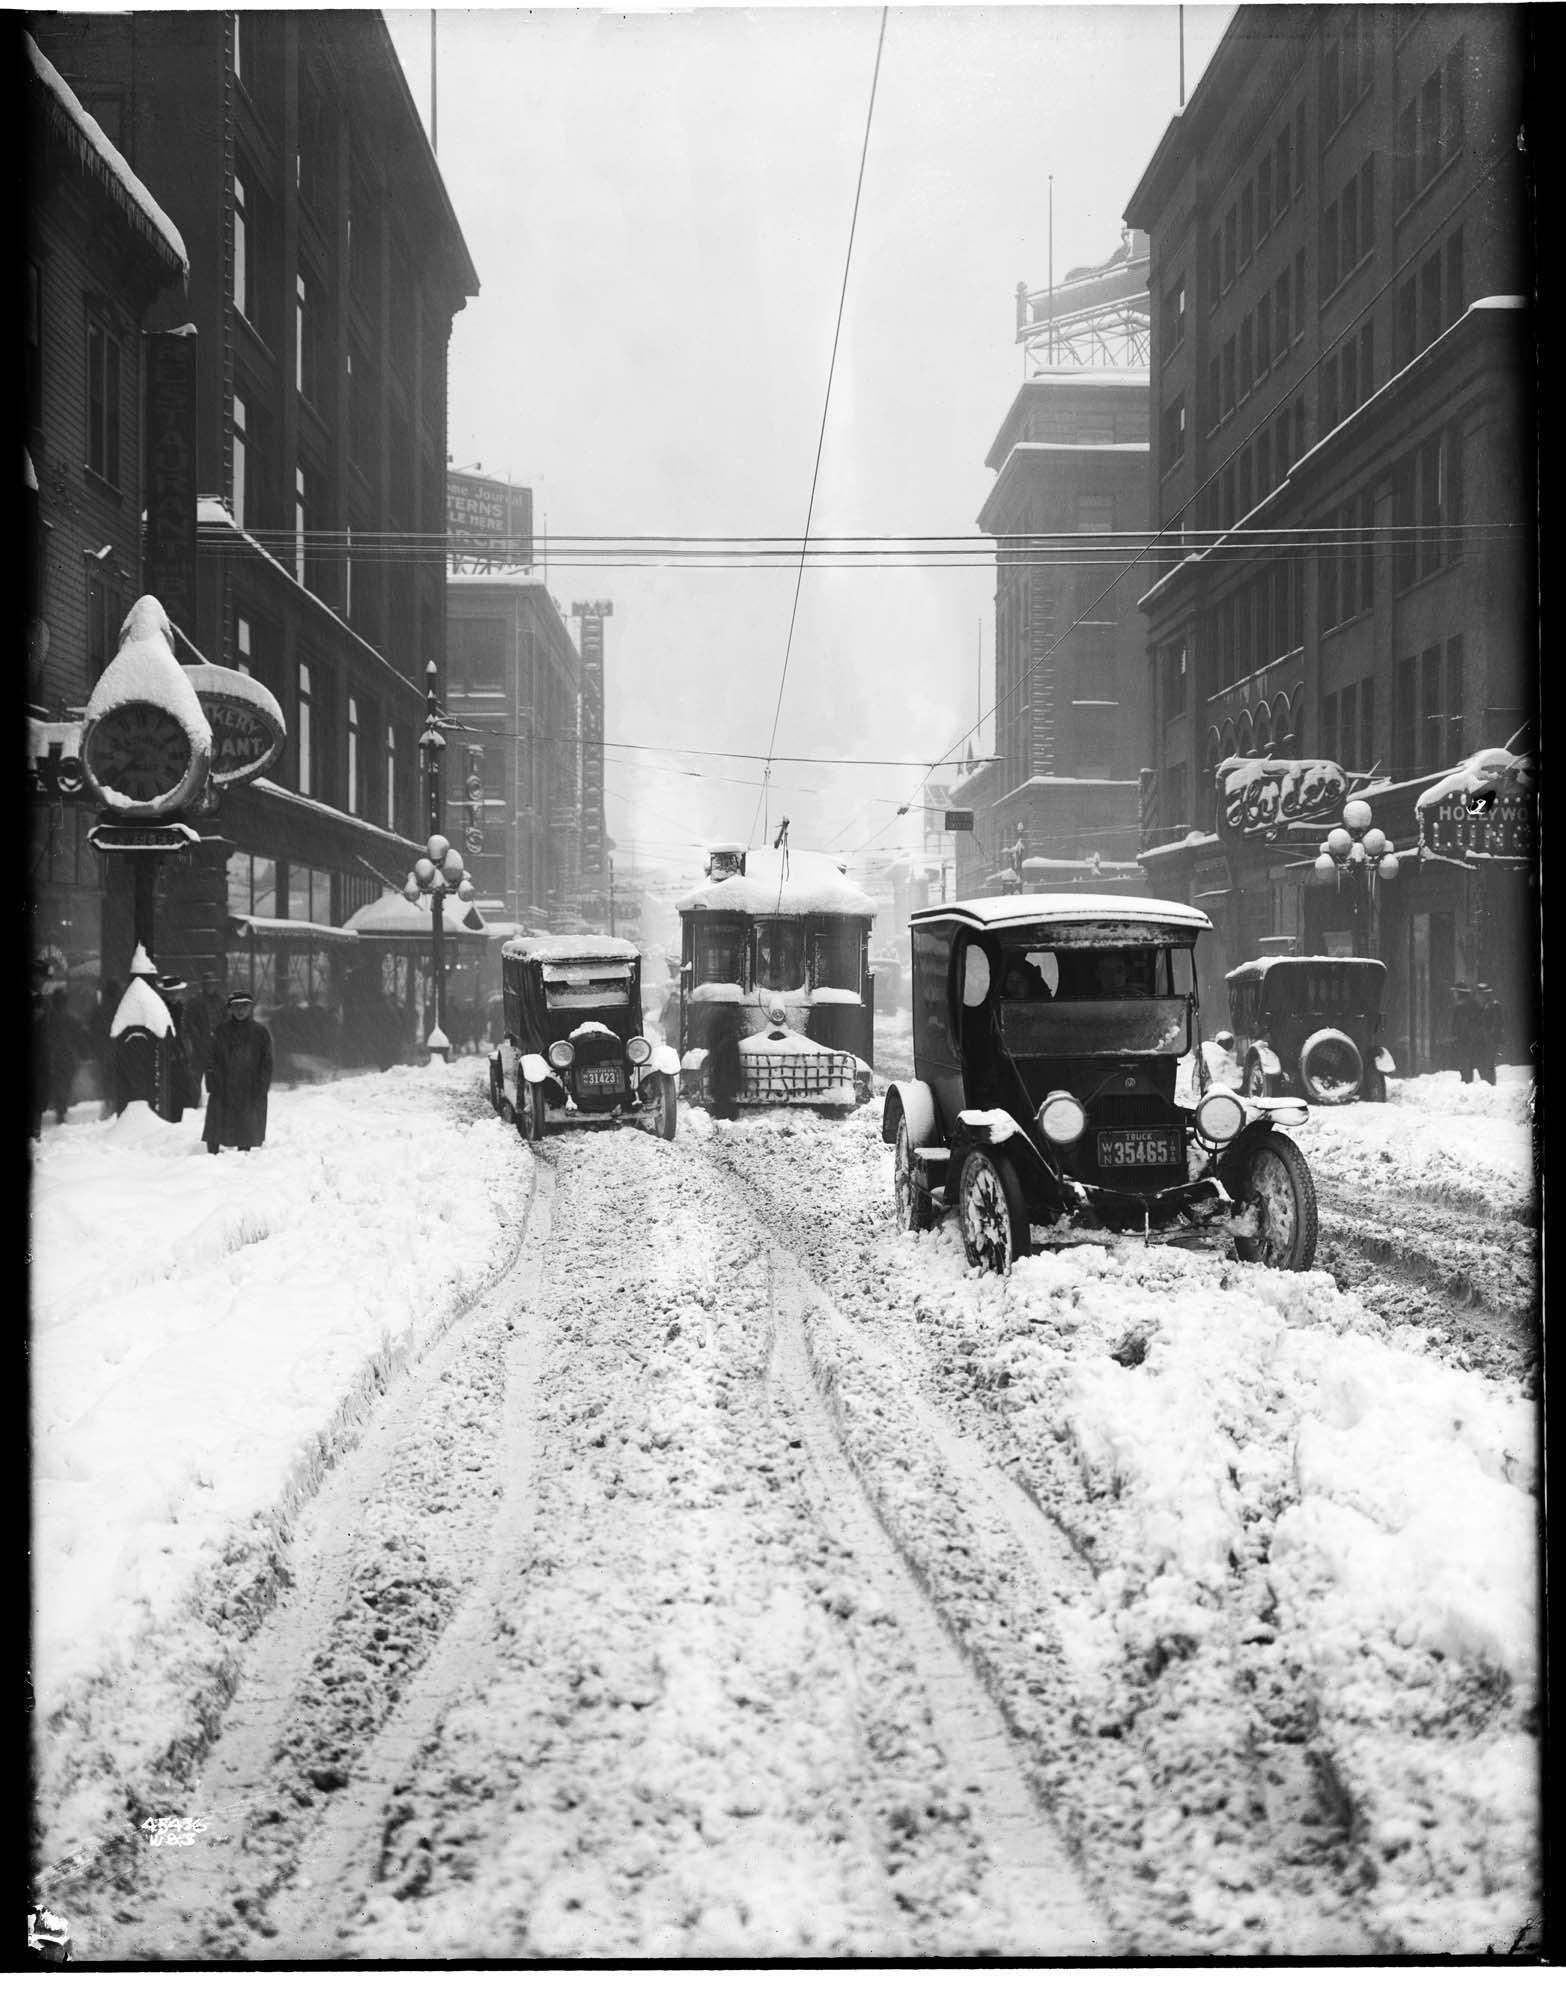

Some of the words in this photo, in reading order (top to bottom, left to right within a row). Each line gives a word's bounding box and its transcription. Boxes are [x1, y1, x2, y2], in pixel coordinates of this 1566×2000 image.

[470, 515, 506, 531] HERE
[213, 737, 264, 758] ANT
[589, 1073, 616, 1085] 31423
[1125, 1132, 1154, 1141] TRUCK
[1114, 1141, 1168, 1164] 35465
